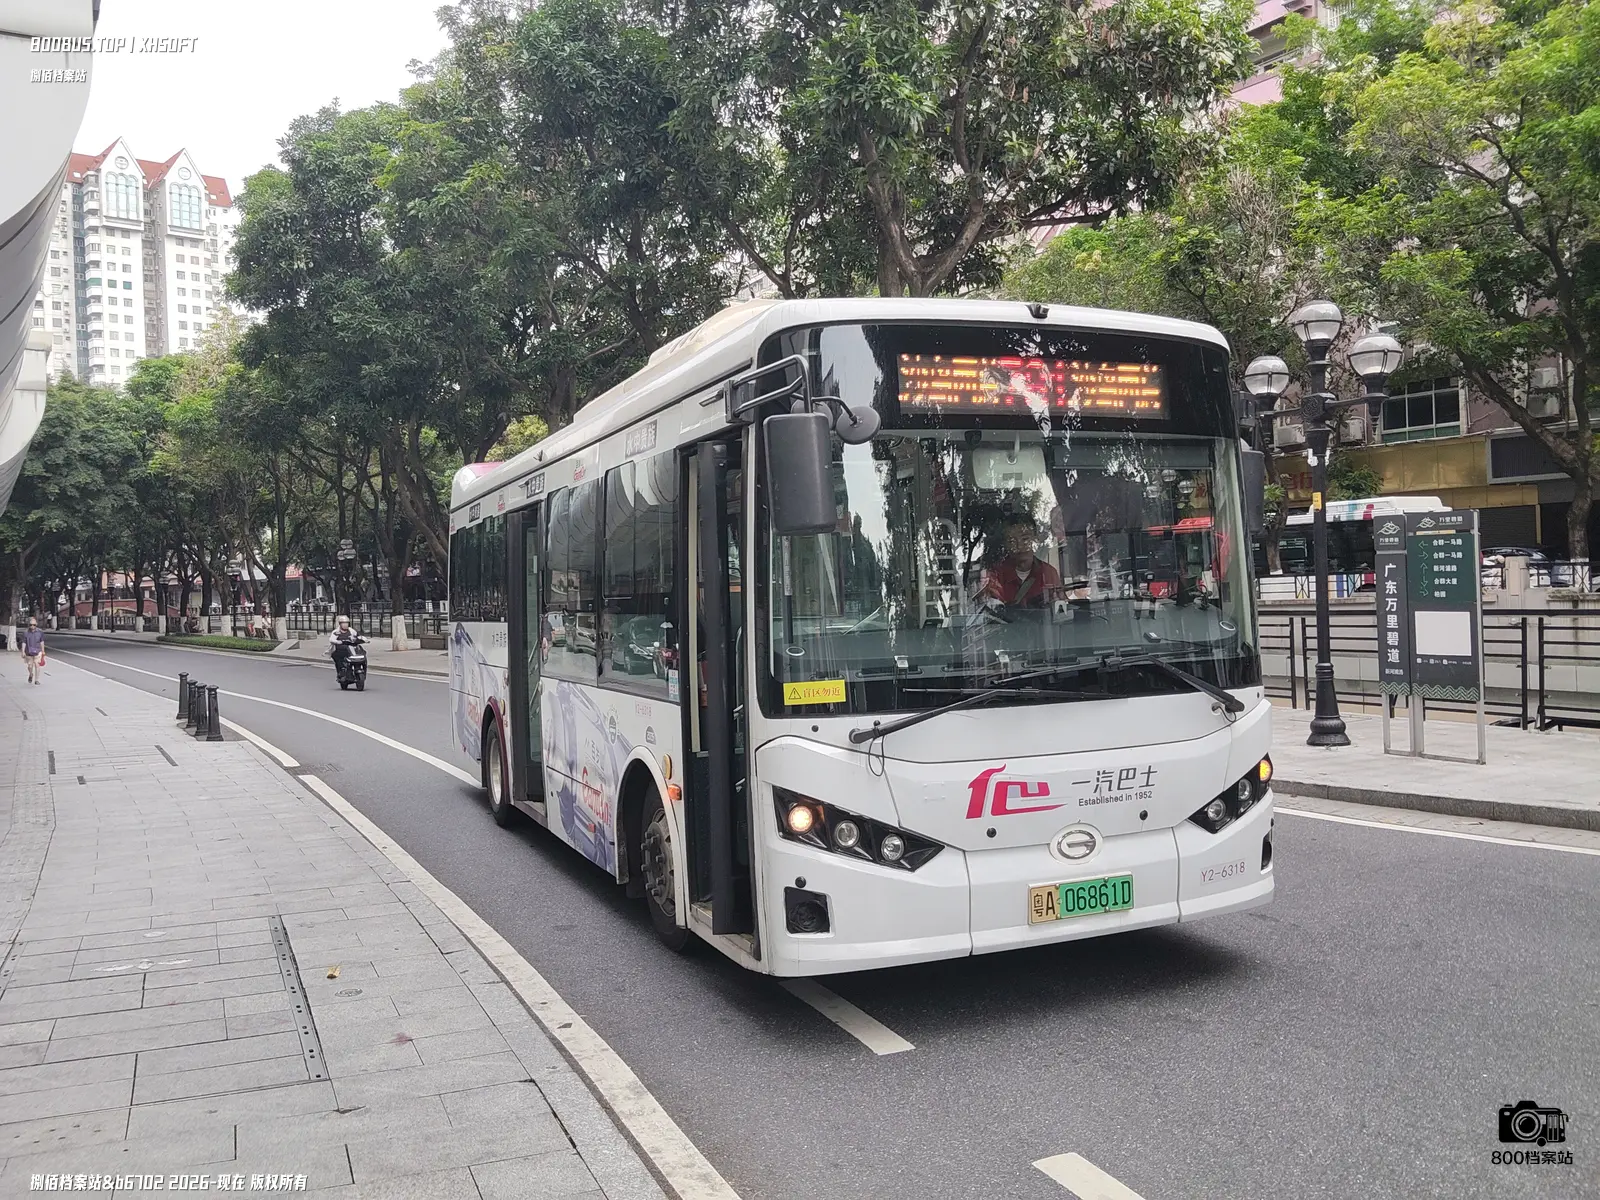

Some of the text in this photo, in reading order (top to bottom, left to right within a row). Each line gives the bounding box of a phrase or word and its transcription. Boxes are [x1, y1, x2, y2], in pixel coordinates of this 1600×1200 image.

[1384, 563, 1400, 663] 广东万里碧道
[803, 686, 841, 698] 盲区勿近
[1071, 765, 1158, 793] 一汽巴士
[1078, 790, 1153, 806] Established in 1952
[1201, 861, 1246, 883] Y2-6318
